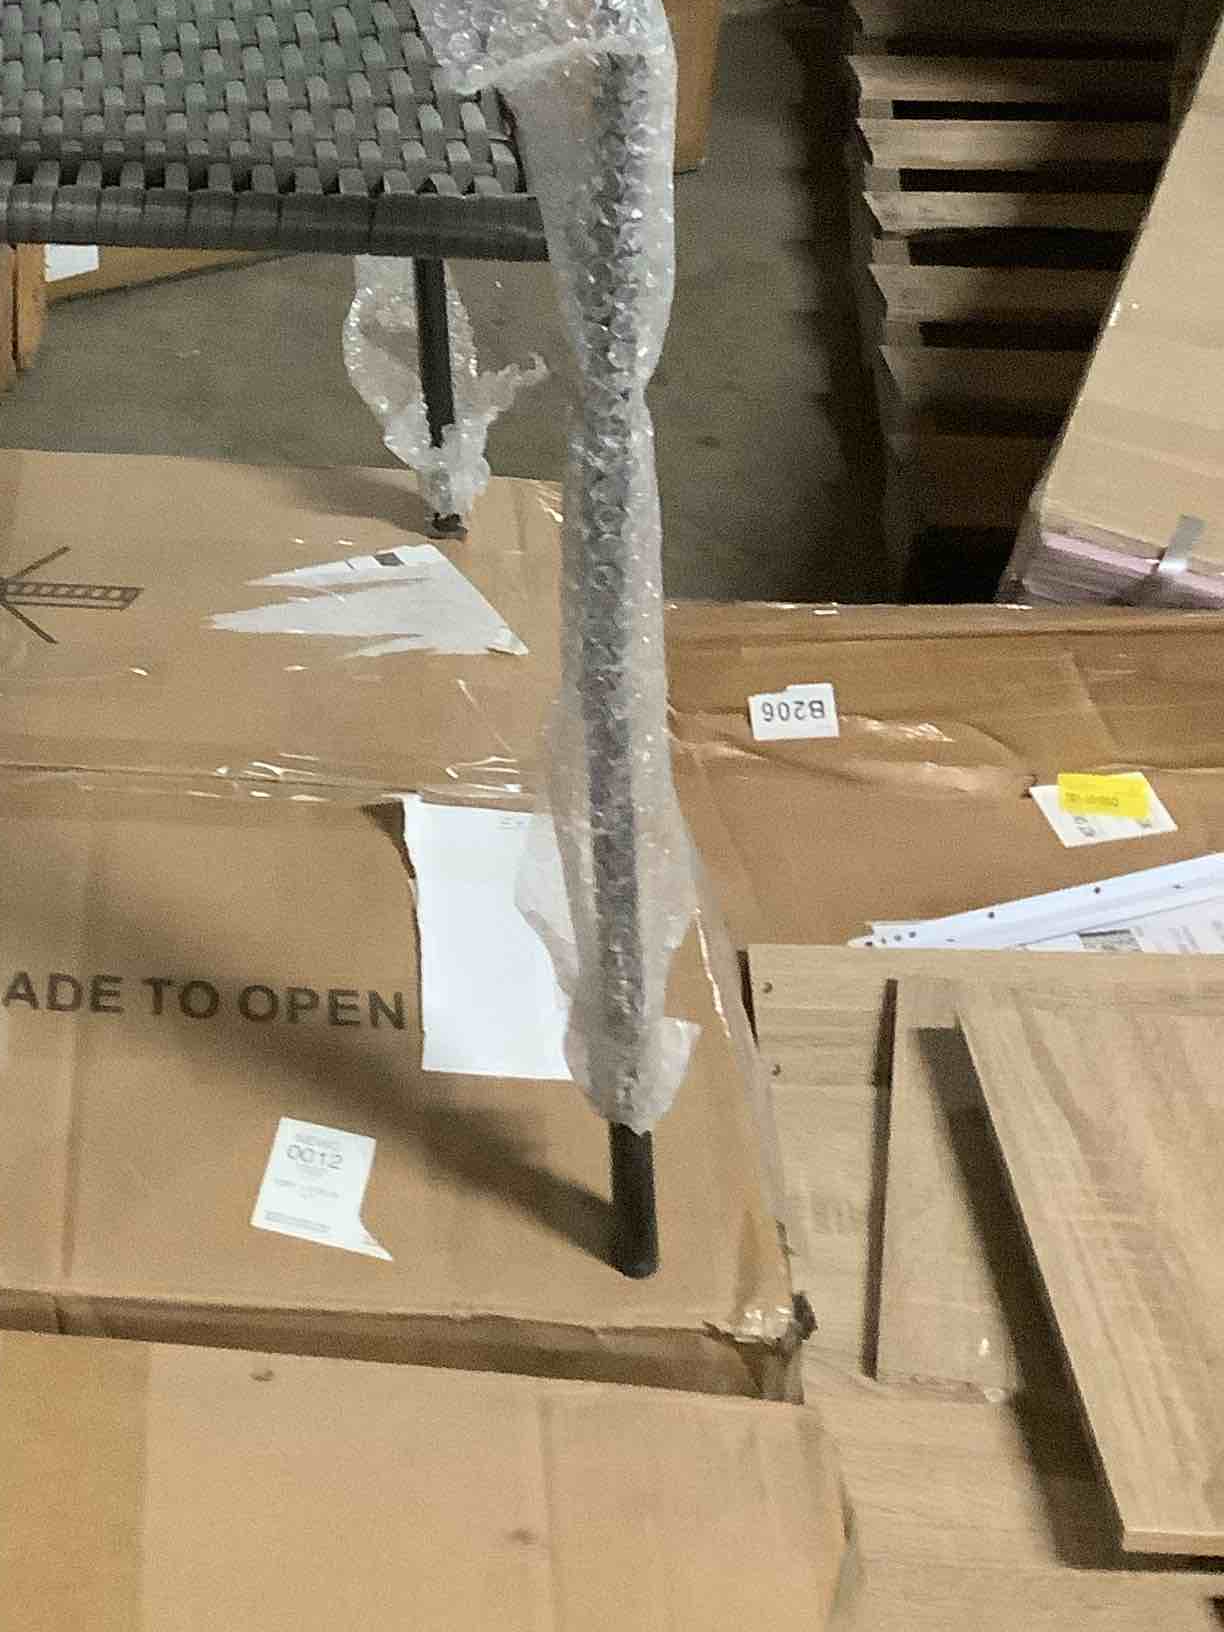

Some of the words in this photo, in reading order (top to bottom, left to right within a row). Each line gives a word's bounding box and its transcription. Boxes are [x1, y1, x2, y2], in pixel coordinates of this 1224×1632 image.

[761, 699, 825, 722] B206
[143, 976, 220, 1020] TO
[238, 984, 407, 1031] OPEN
[287, 1144, 343, 1170] 0012
